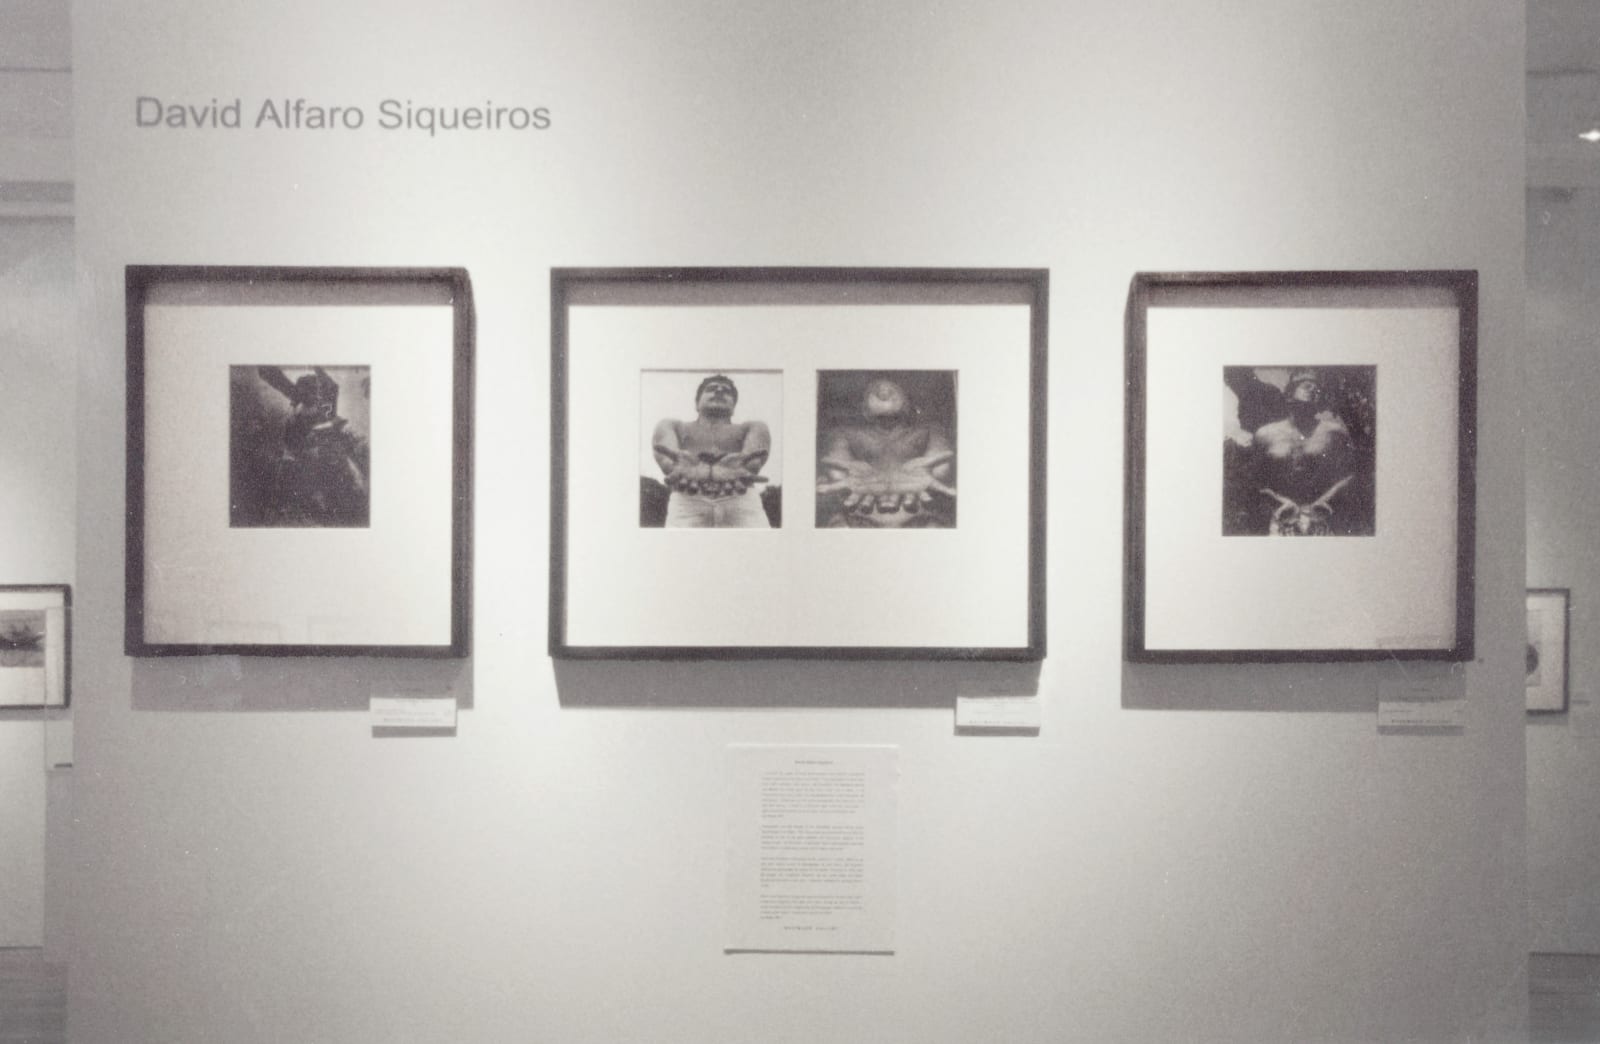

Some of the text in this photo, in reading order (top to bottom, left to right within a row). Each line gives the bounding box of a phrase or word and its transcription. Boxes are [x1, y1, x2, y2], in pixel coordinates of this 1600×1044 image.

[136, 97, 551, 136] David Alfaro Siqueiros
